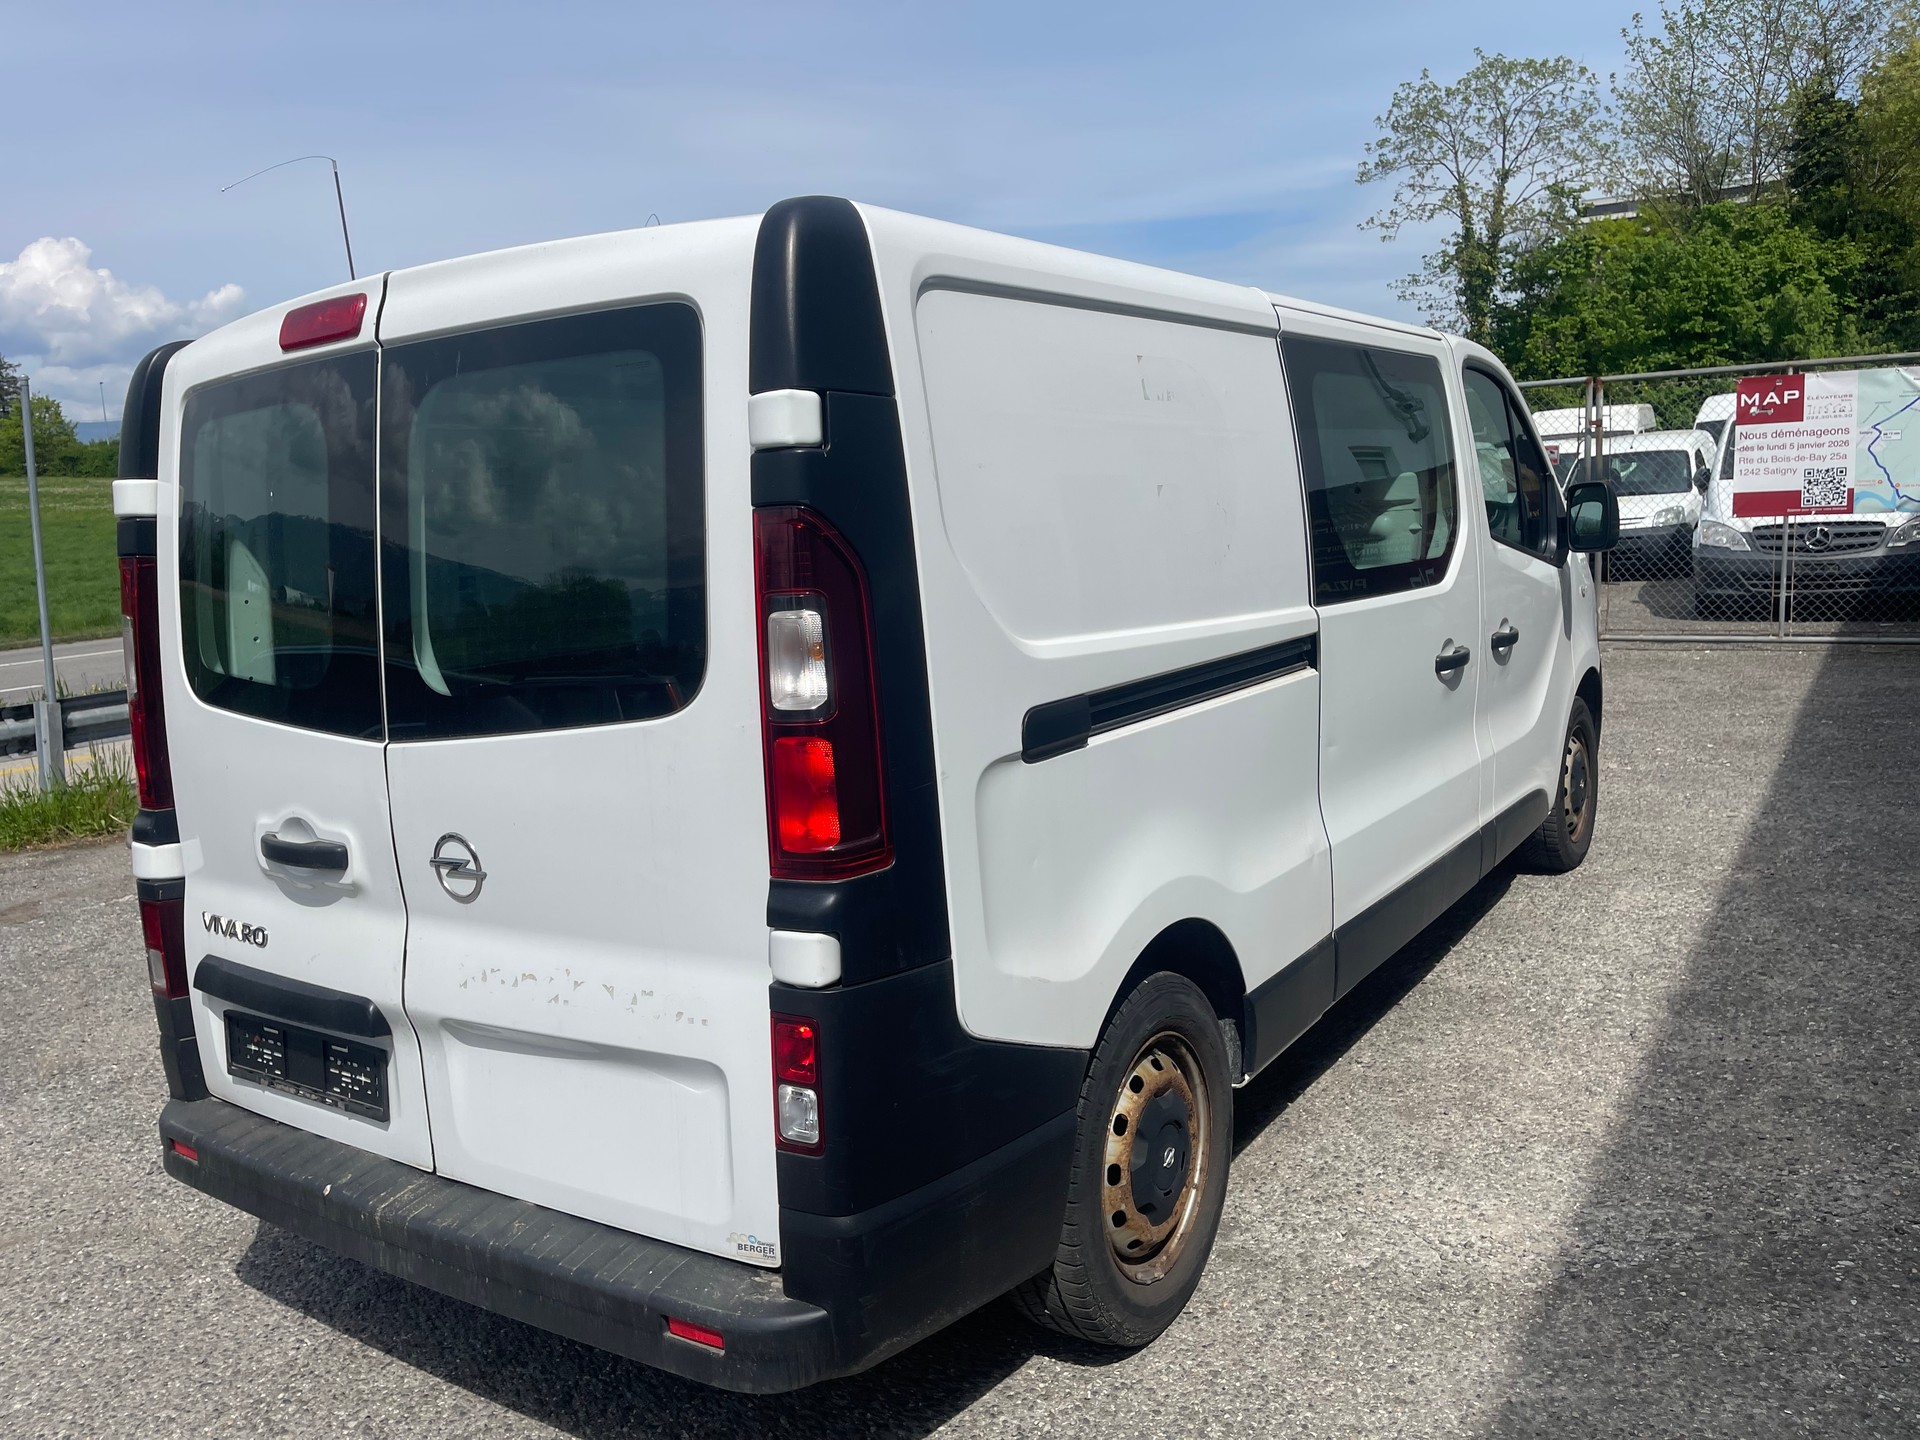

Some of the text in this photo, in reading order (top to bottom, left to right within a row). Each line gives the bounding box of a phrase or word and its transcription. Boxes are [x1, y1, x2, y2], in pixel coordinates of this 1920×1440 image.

[1741, 390, 1799, 407] MAP
[1740, 427, 1850, 440] Nous déménageons
[1767, 442, 1787, 451] lundi
[1796, 441, 1825, 451] janvier
[1828, 440, 1850, 448] 2026
[1771, 453, 1827, 463] Bois-de-Bay
[1739, 467, 1797, 476] 1242 Satigny
[202, 911, 268, 948] VIVARO
[738, 1243, 775, 1255] BERGER
